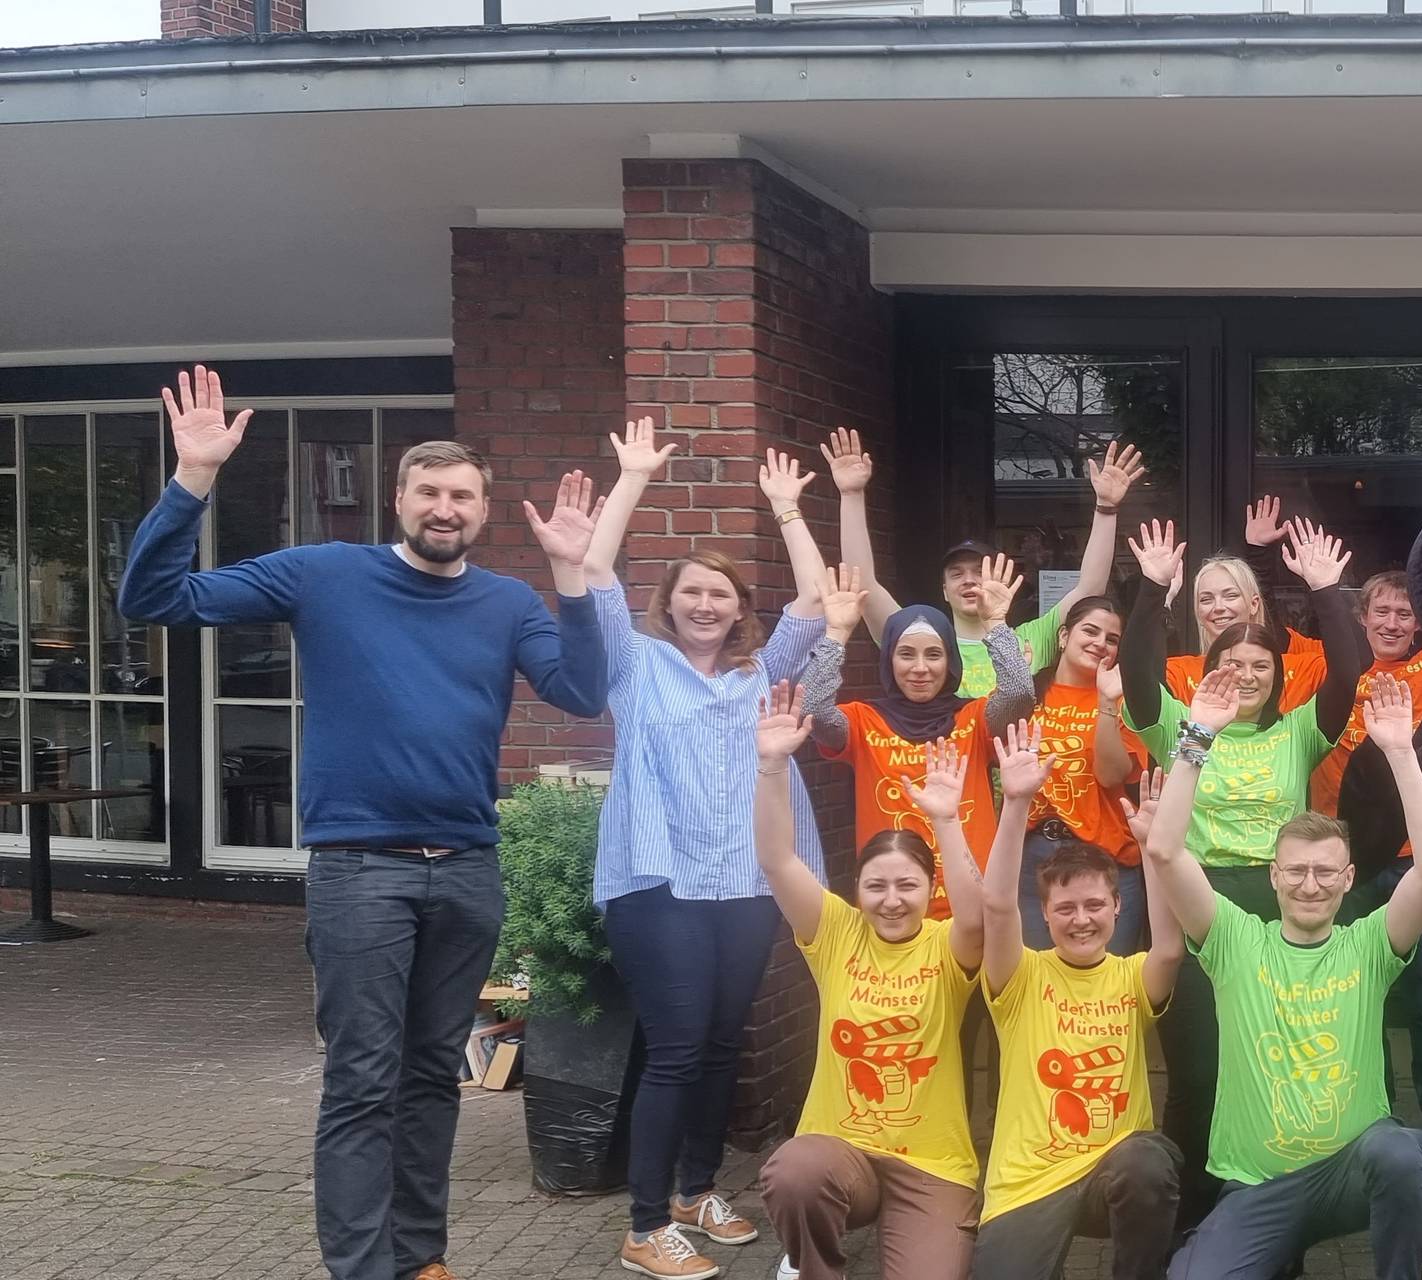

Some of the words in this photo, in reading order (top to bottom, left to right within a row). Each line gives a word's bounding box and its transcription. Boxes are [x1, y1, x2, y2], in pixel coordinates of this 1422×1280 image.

[850, 985, 926, 1009] Münster
[1258, 964, 1361, 1003] KerFlmFest
[1042, 983, 1138, 1018] KderFilmFs
[1057, 1015, 1130, 1037] Münster
